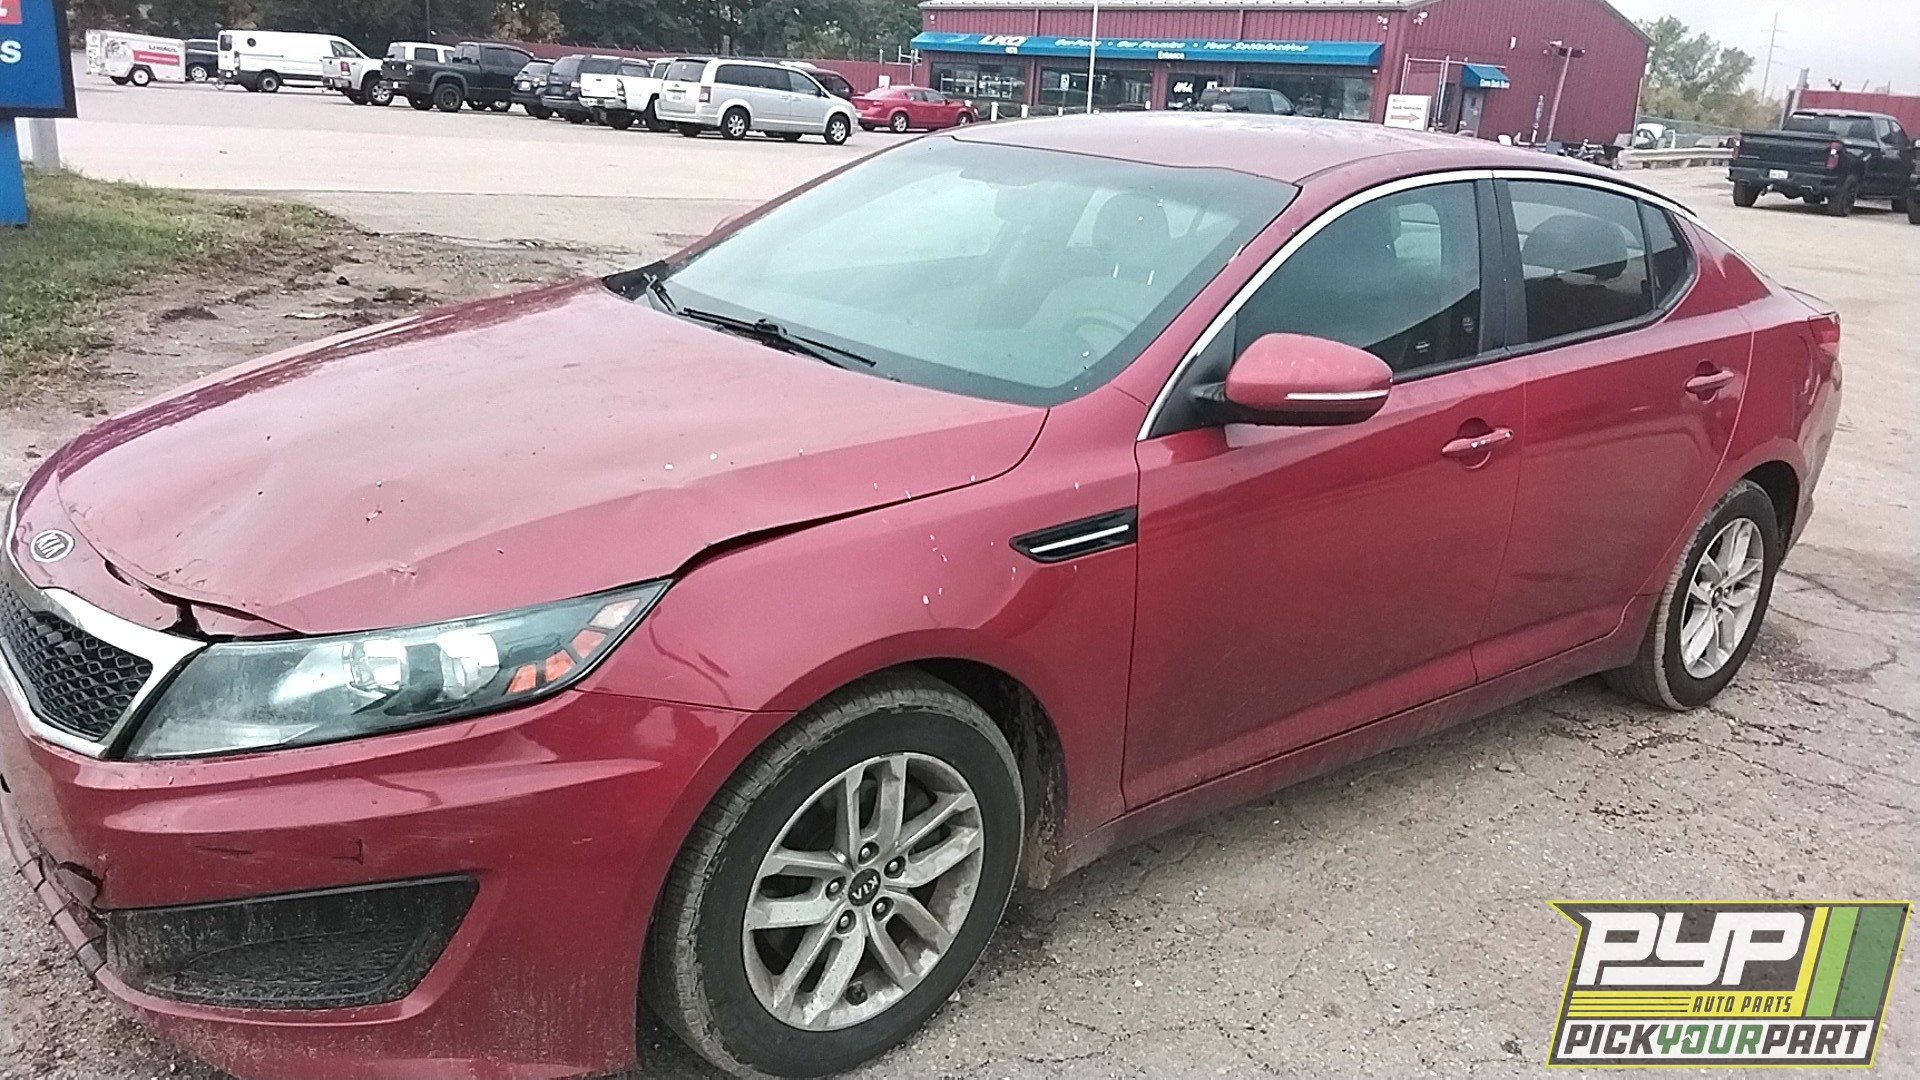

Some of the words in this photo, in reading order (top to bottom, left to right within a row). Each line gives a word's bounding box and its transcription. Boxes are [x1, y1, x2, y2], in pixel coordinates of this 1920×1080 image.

[978, 35, 1029, 46] LKQ
[1073, 39, 1102, 47] Pars
[852, 875, 879, 900] KIA
